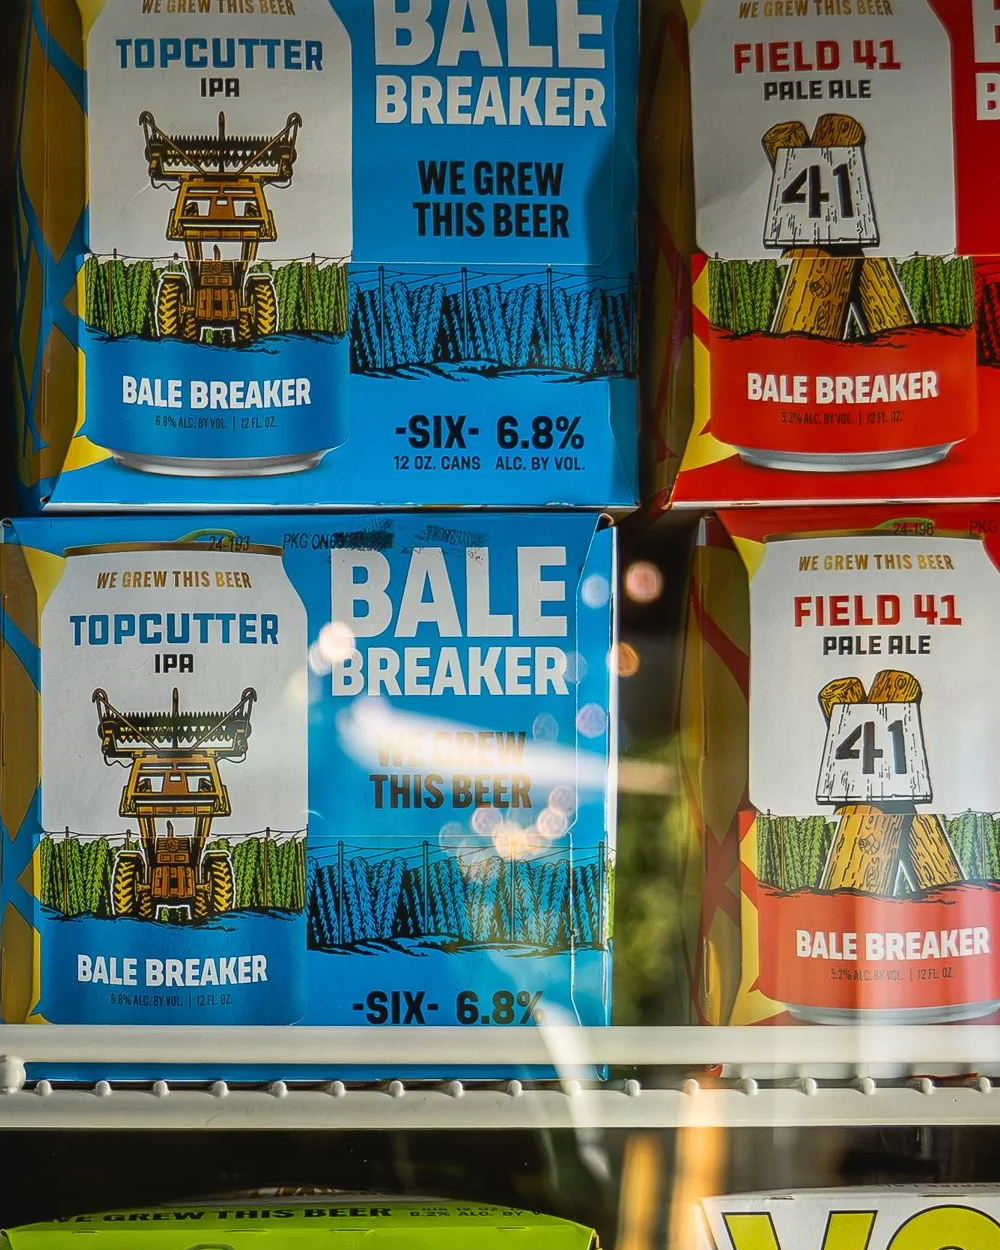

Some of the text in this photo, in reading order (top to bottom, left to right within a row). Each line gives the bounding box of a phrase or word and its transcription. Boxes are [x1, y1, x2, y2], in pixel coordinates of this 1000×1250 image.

[116, 38, 324, 71] TOPCUTTER
[734, 40, 900, 74] FIELD 41
[200, 78, 239, 98] IPA
[376, 75, 607, 127] BREAKER
[764, 80, 871, 100] PALE ALE
[417, 160, 564, 197] WE GREW
[782, 162, 854, 219] 41
[412, 202, 569, 238] THIS BEER
[497, 415, 584, 449] 6.8%
[394, 456, 586, 470] 12 OZ. CANS ALC. BY VOL.
[97, 571, 252, 589] WE GREW THIS BEER
[330, 547, 568, 638] BALE
[793, 595, 962, 627] FIELD 41
[70, 612, 279, 646] TOPCUTTER
[823, 635, 930, 656] PALE ALE
[330, 646, 569, 697] BREAKER
[836, 720, 909, 775] 41
